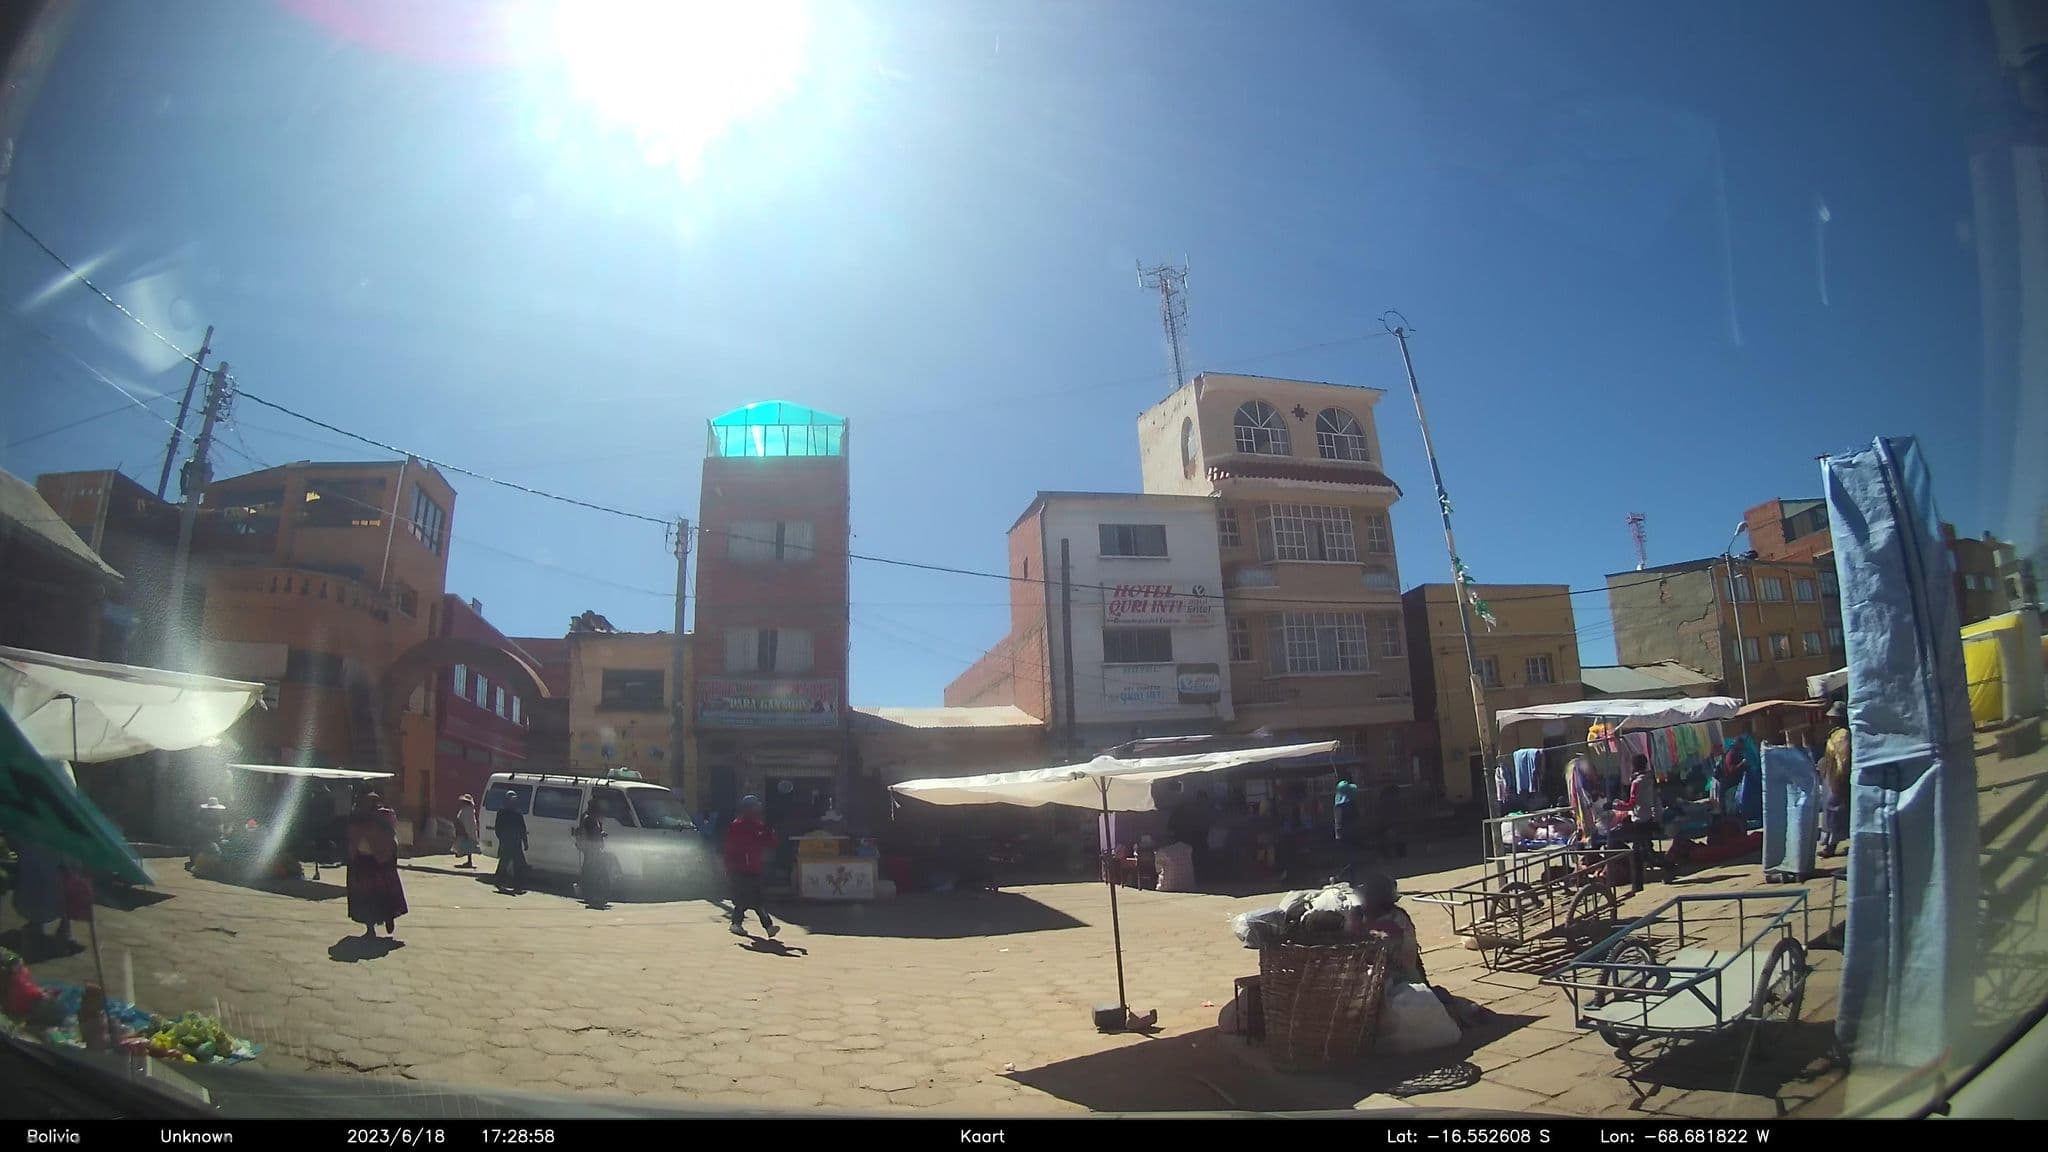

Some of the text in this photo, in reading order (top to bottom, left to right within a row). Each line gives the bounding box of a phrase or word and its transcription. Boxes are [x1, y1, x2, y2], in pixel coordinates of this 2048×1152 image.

[1114, 584, 1175, 598] HOTEL
[1109, 599, 1183, 617] QURI INTI
